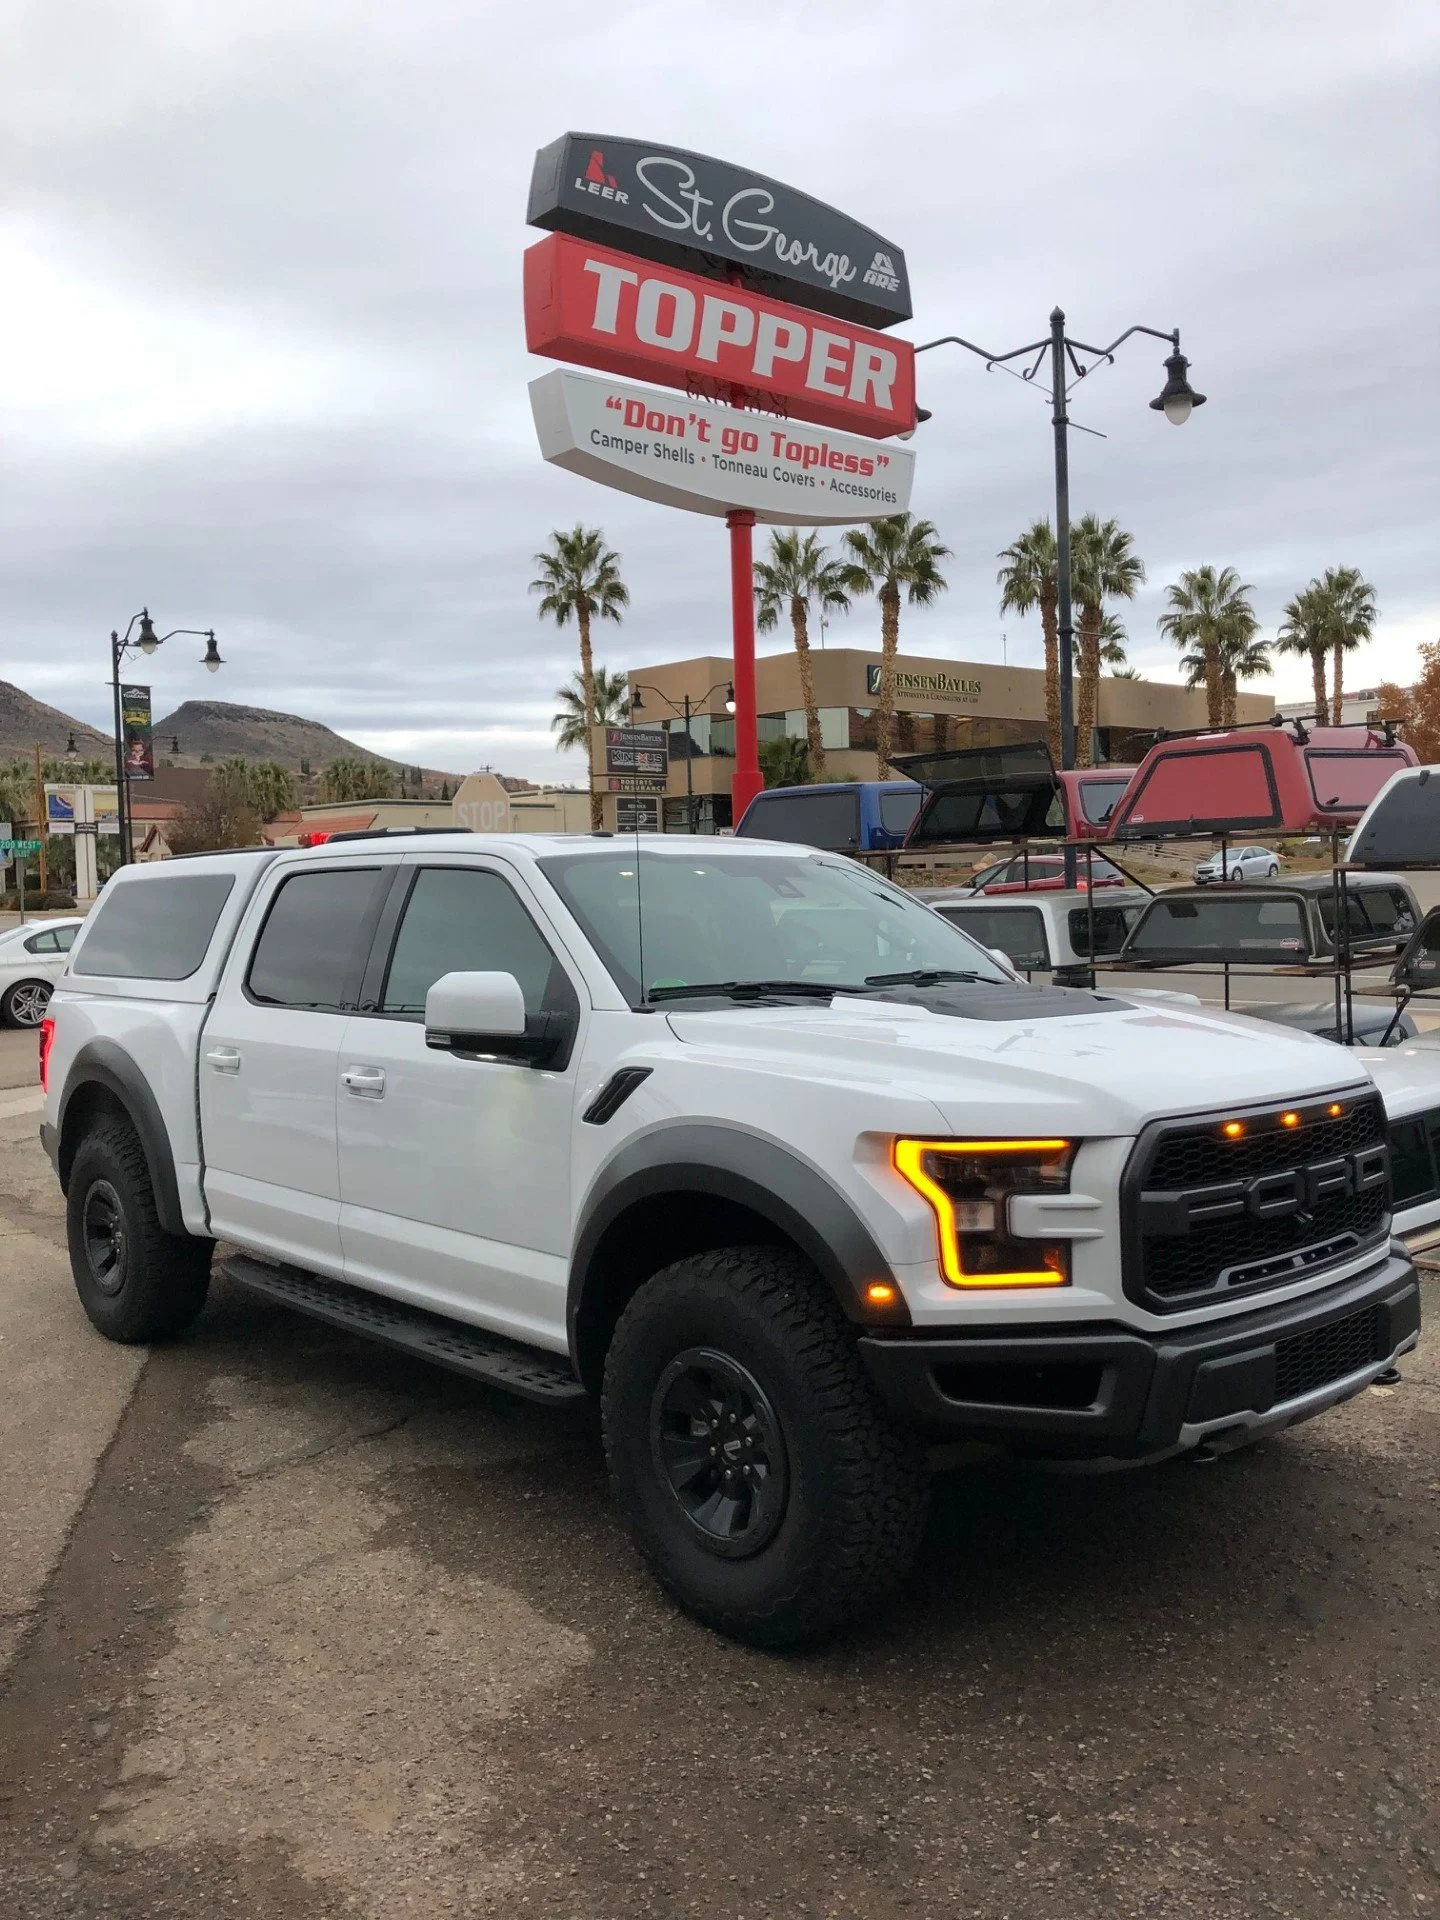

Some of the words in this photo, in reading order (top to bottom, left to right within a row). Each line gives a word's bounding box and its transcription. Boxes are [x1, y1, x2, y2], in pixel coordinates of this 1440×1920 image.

[574, 177, 629, 205] LEER
[635, 156, 714, 242] St.
[722, 188, 857, 288] George
[862, 269, 900, 292] ARE
[584, 258, 898, 411] TOPPER
[605, 396, 711, 443] “Don’t
[721, 428, 759, 455] go
[771, 431, 889, 477] Topless”
[590, 429, 649, 455] Camper
[654, 443, 695, 464] Shells
[712, 454, 767, 479] Tonneau
[773, 467, 815, 487] Covers
[830, 478, 897, 503] Accessories
[895, 673, 981, 693] ENSENBAYLES
[611, 750, 662, 763] KINEXUS
[621, 784, 666, 792] INSURANCE
[458, 800, 505, 831] STOP
[17, 840, 36, 849] WEST
[1160, 1144, 1392, 1233] FORD
